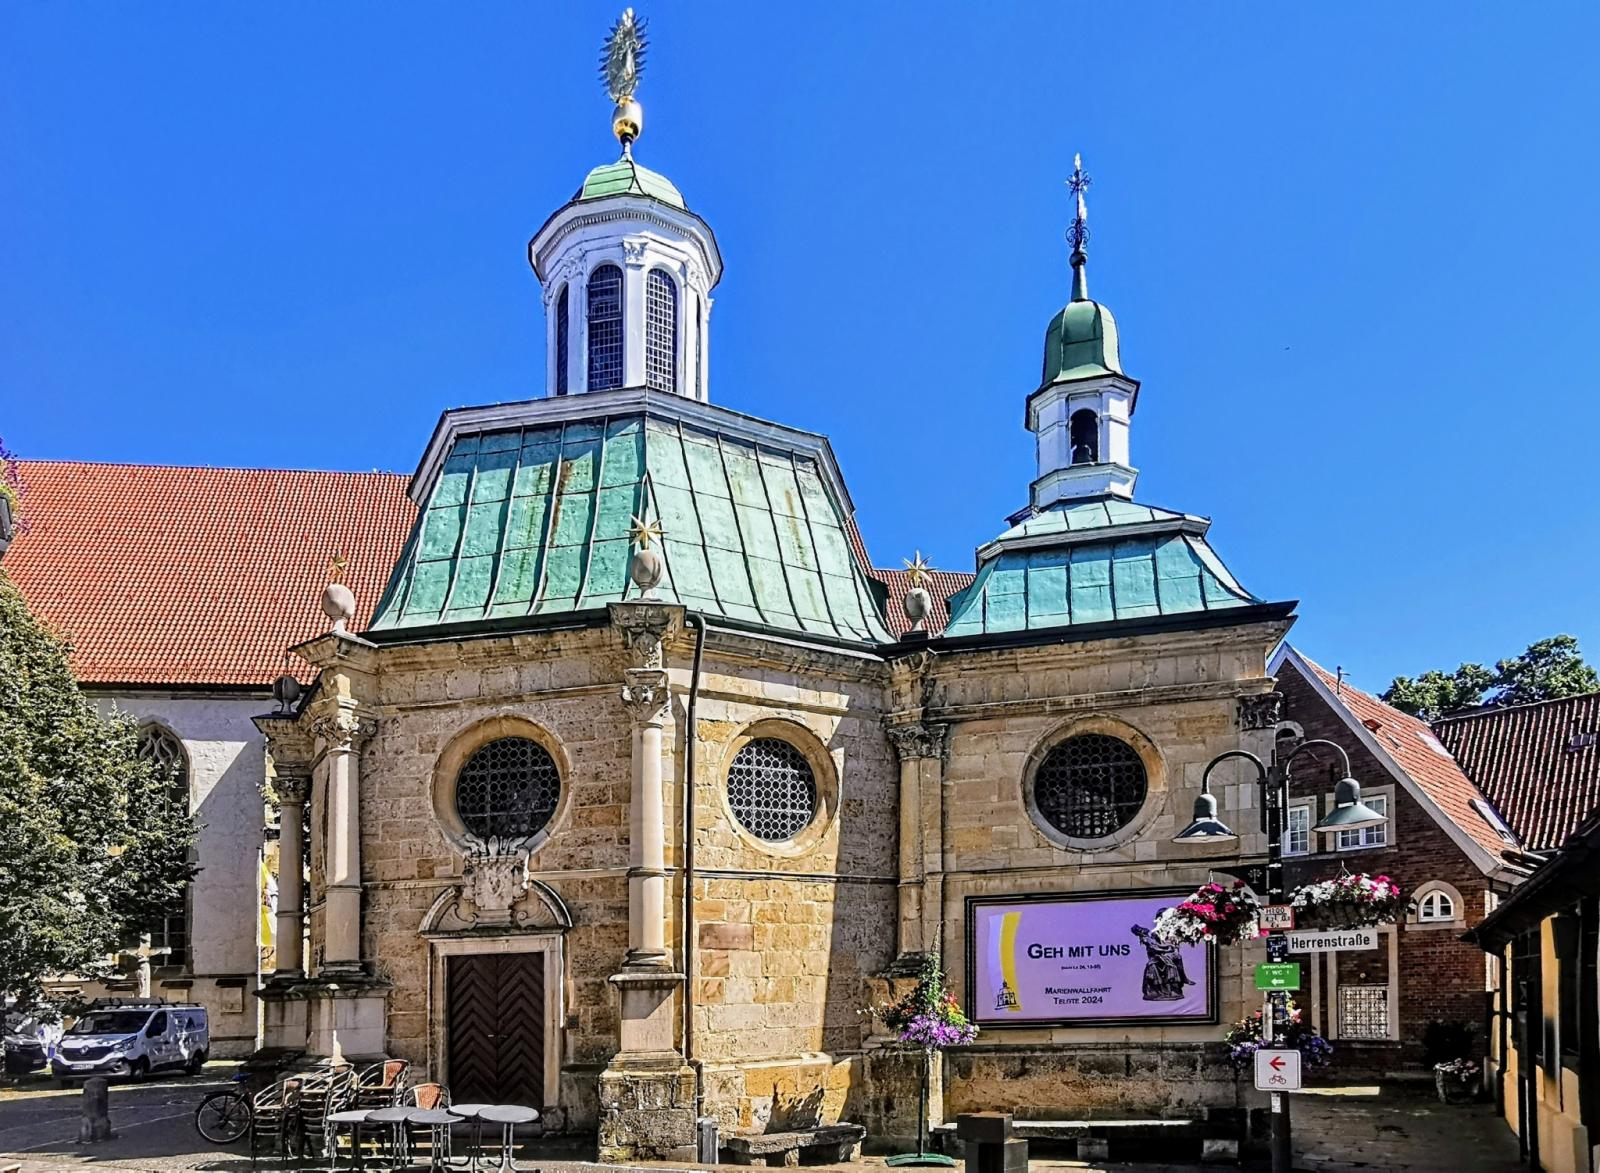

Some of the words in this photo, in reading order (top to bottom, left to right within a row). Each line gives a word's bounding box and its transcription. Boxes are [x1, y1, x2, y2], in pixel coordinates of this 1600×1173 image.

[1291, 933, 1370, 949] Herrenstraße
[1027, 943, 1064, 959] GEH
[1068, 945, 1094, 958] MIT
[1099, 944, 1130, 956] UNS
[1081, 996, 1103, 1004] 2024
